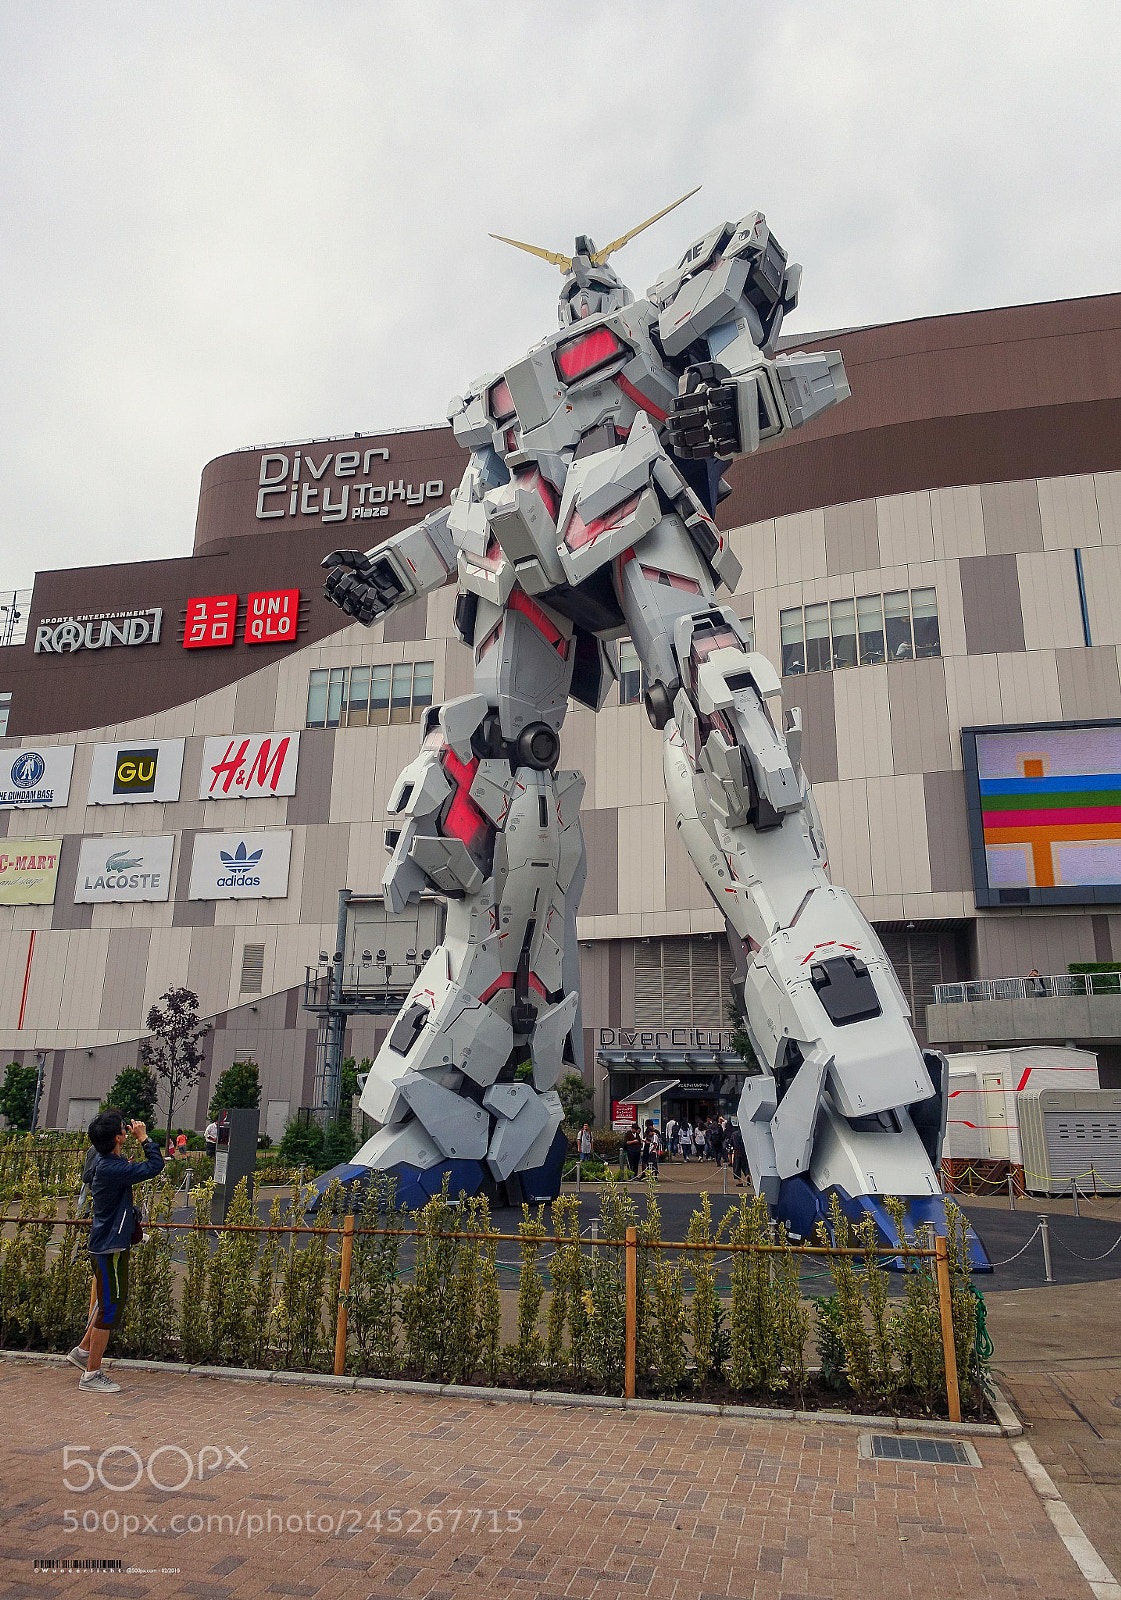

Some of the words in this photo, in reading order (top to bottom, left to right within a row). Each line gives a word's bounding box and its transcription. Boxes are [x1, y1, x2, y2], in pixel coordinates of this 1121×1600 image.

[259, 448, 389, 486] Diver
[255, 482, 350, 522] City
[352, 479, 444, 506] Tokyo
[351, 506, 389, 520] Plaza
[40, 616, 75, 625] SPORTS
[76, 609, 150, 621] ENTERTAINMENT
[252, 596, 290, 616] UNI
[34, 607, 163, 654] ROUND1
[250, 616, 292, 639] QLO
[117, 761, 155, 783] GU
[209, 737, 291, 793] H&M
[8, 790, 37, 800] GUNDAM
[37, 789, 54, 799] BASE
[84, 873, 161, 890] LACOSTE
[216, 874, 261, 887] adidas
[600, 1028, 722, 1051] DiverCity
